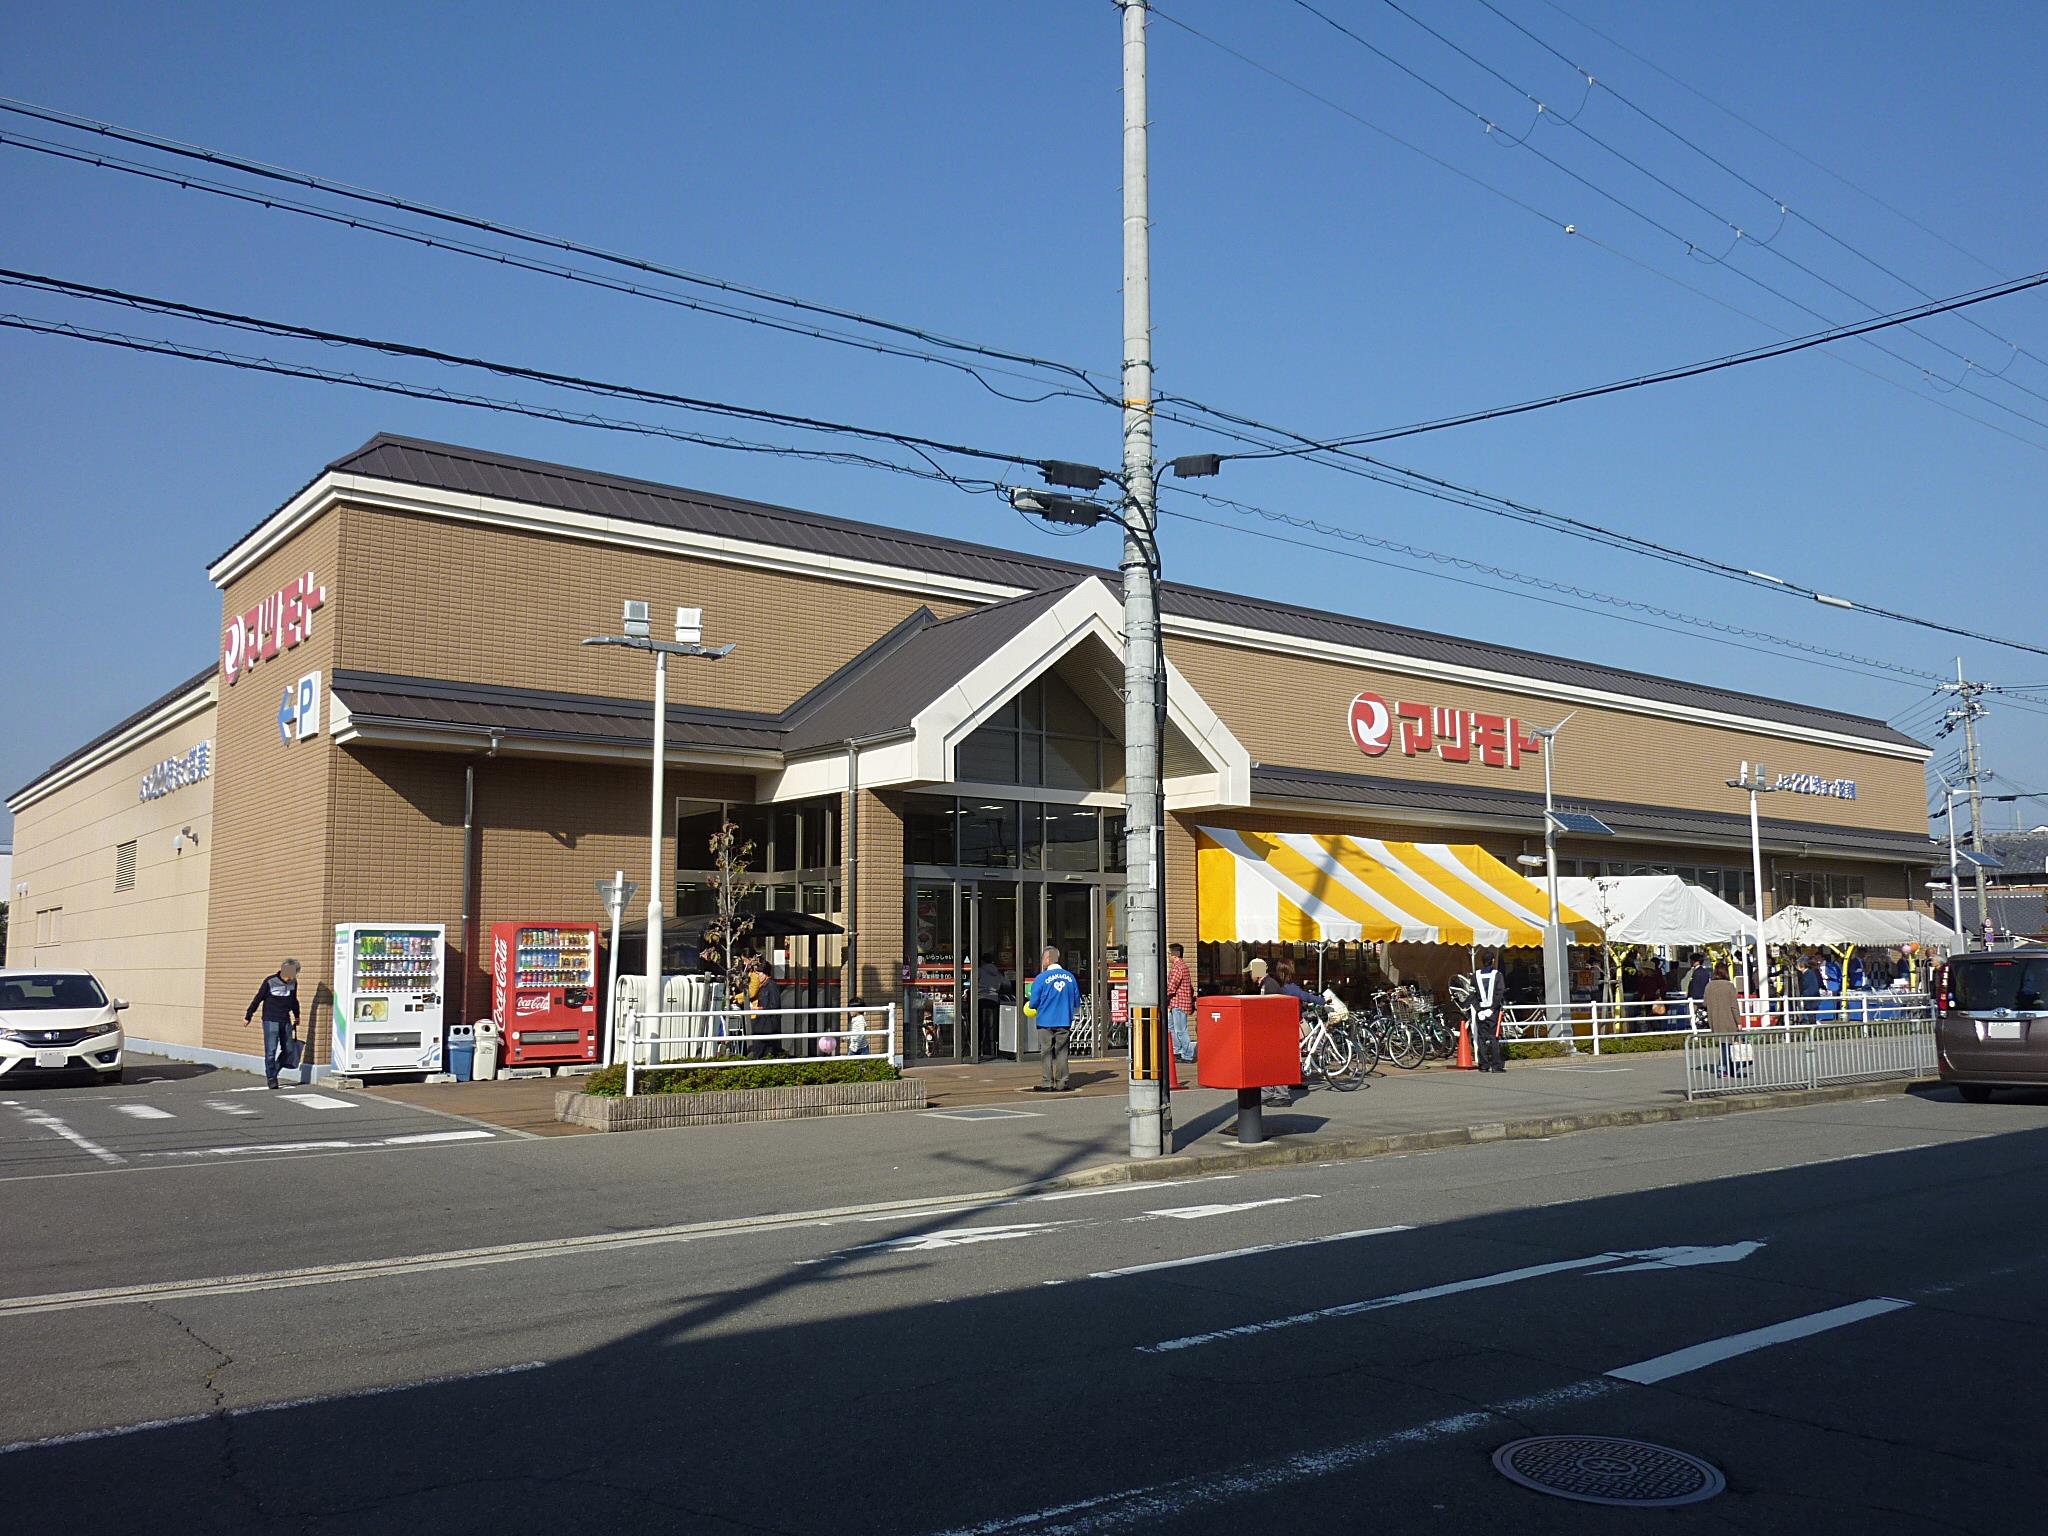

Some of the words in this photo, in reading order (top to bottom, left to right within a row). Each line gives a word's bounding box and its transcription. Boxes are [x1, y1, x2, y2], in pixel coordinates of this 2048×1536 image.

[244, 571, 326, 672] マツモト
[298, 678, 314, 735] P
[1395, 700, 1540, 769] マツモト
